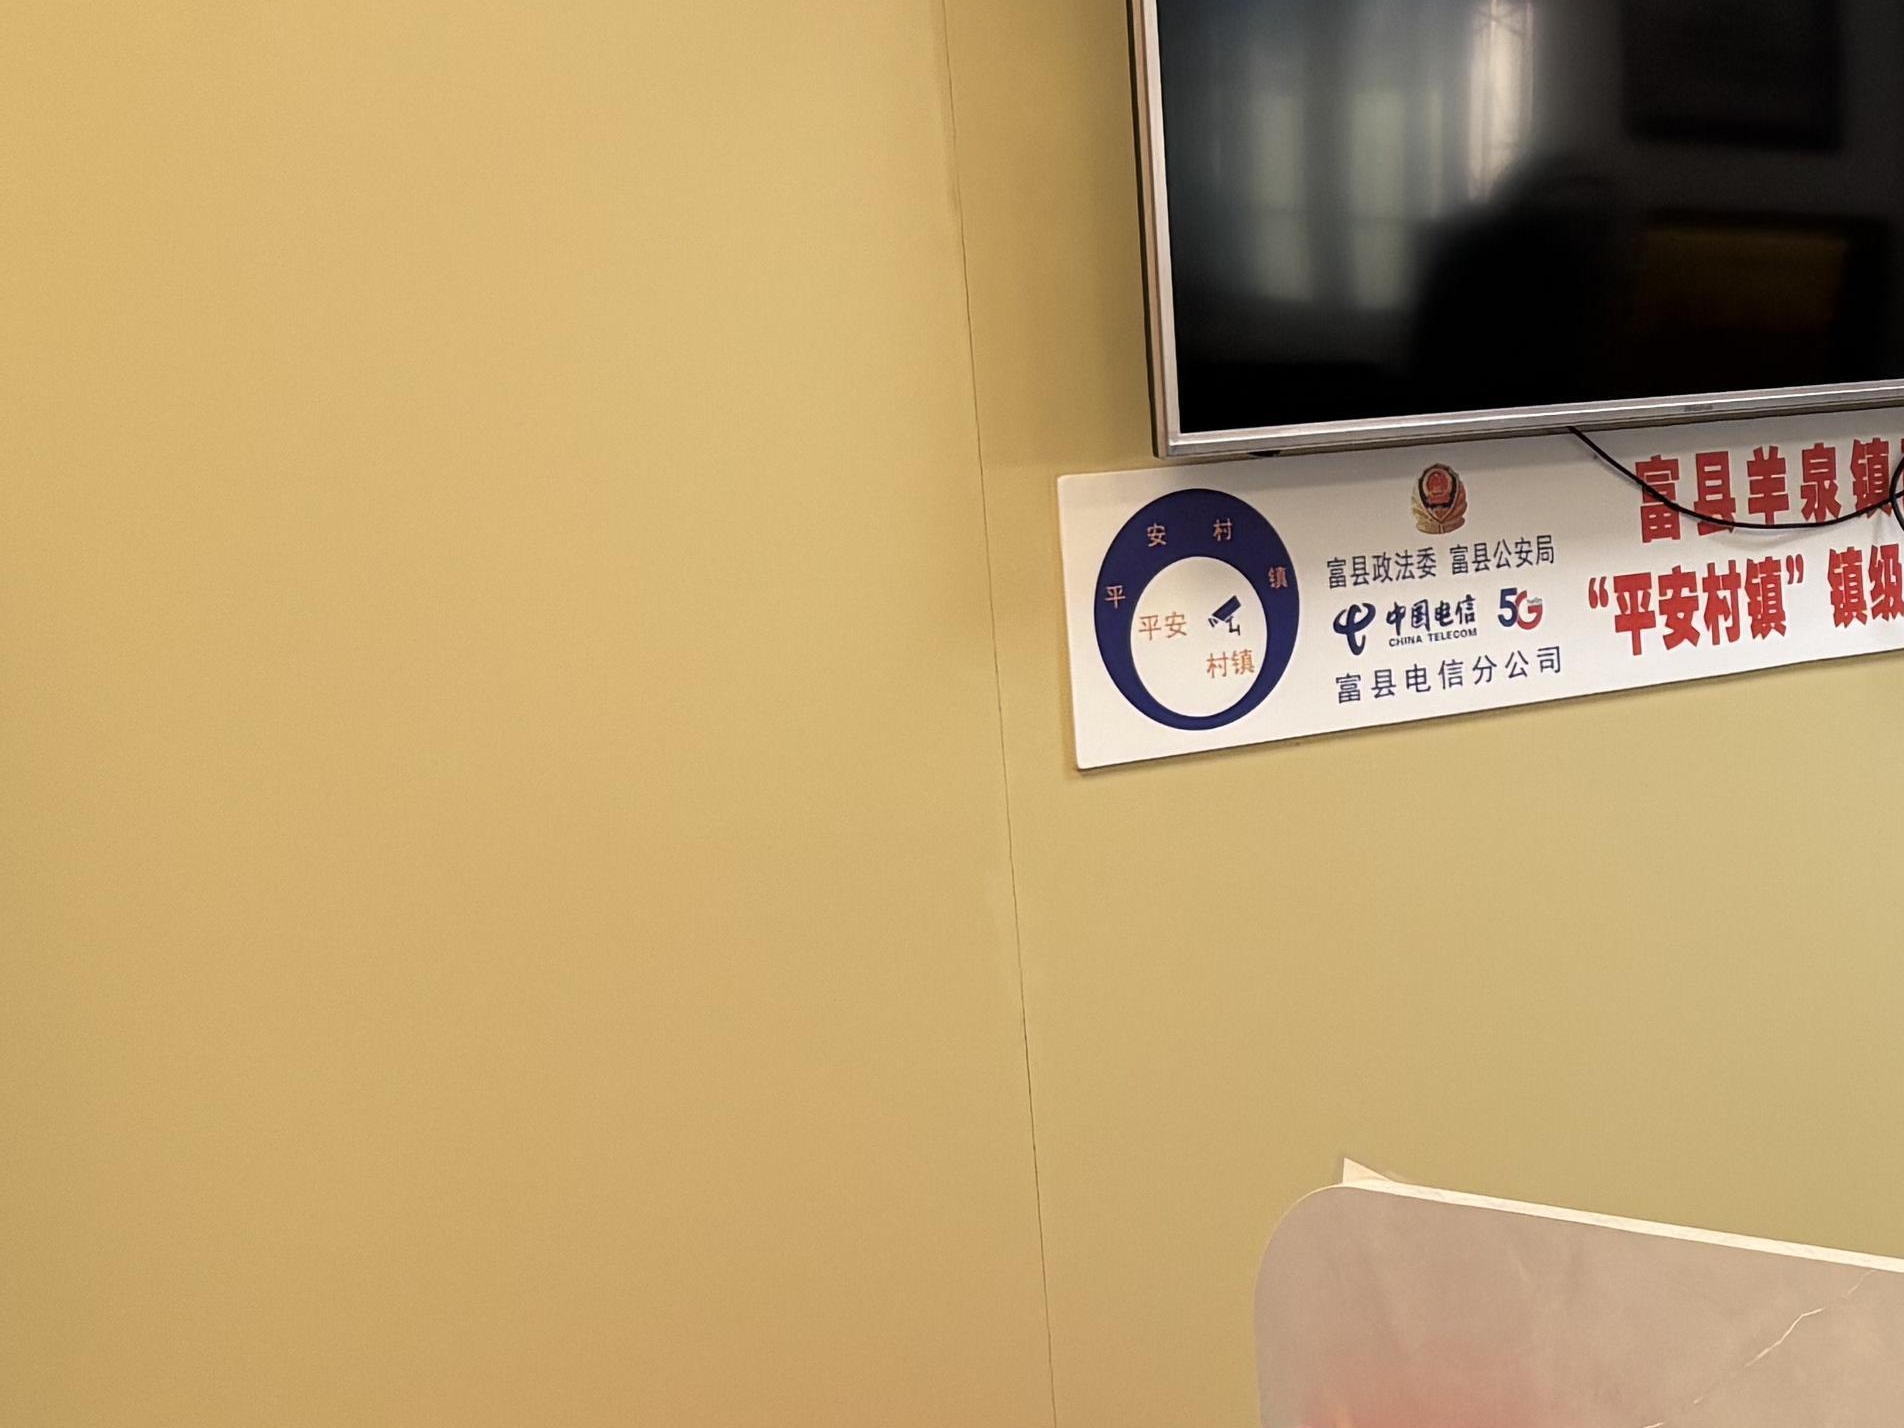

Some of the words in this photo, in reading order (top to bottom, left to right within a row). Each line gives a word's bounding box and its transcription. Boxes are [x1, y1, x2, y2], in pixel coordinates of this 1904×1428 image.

[1326, 546, 1438, 590] 富县政法委
[1449, 534, 1556, 575] 富县公安局
[1138, 611, 1188, 641] 平安
[1385, 593, 1477, 636] 中国电信
[1497, 587, 1544, 630] 5G
[1388, 635, 1423, 648] CHINA
[1428, 627, 1478, 643] TELECOM
[1206, 648, 1256, 679] 村镇
[1335, 645, 1563, 704] 富县电信分公司
